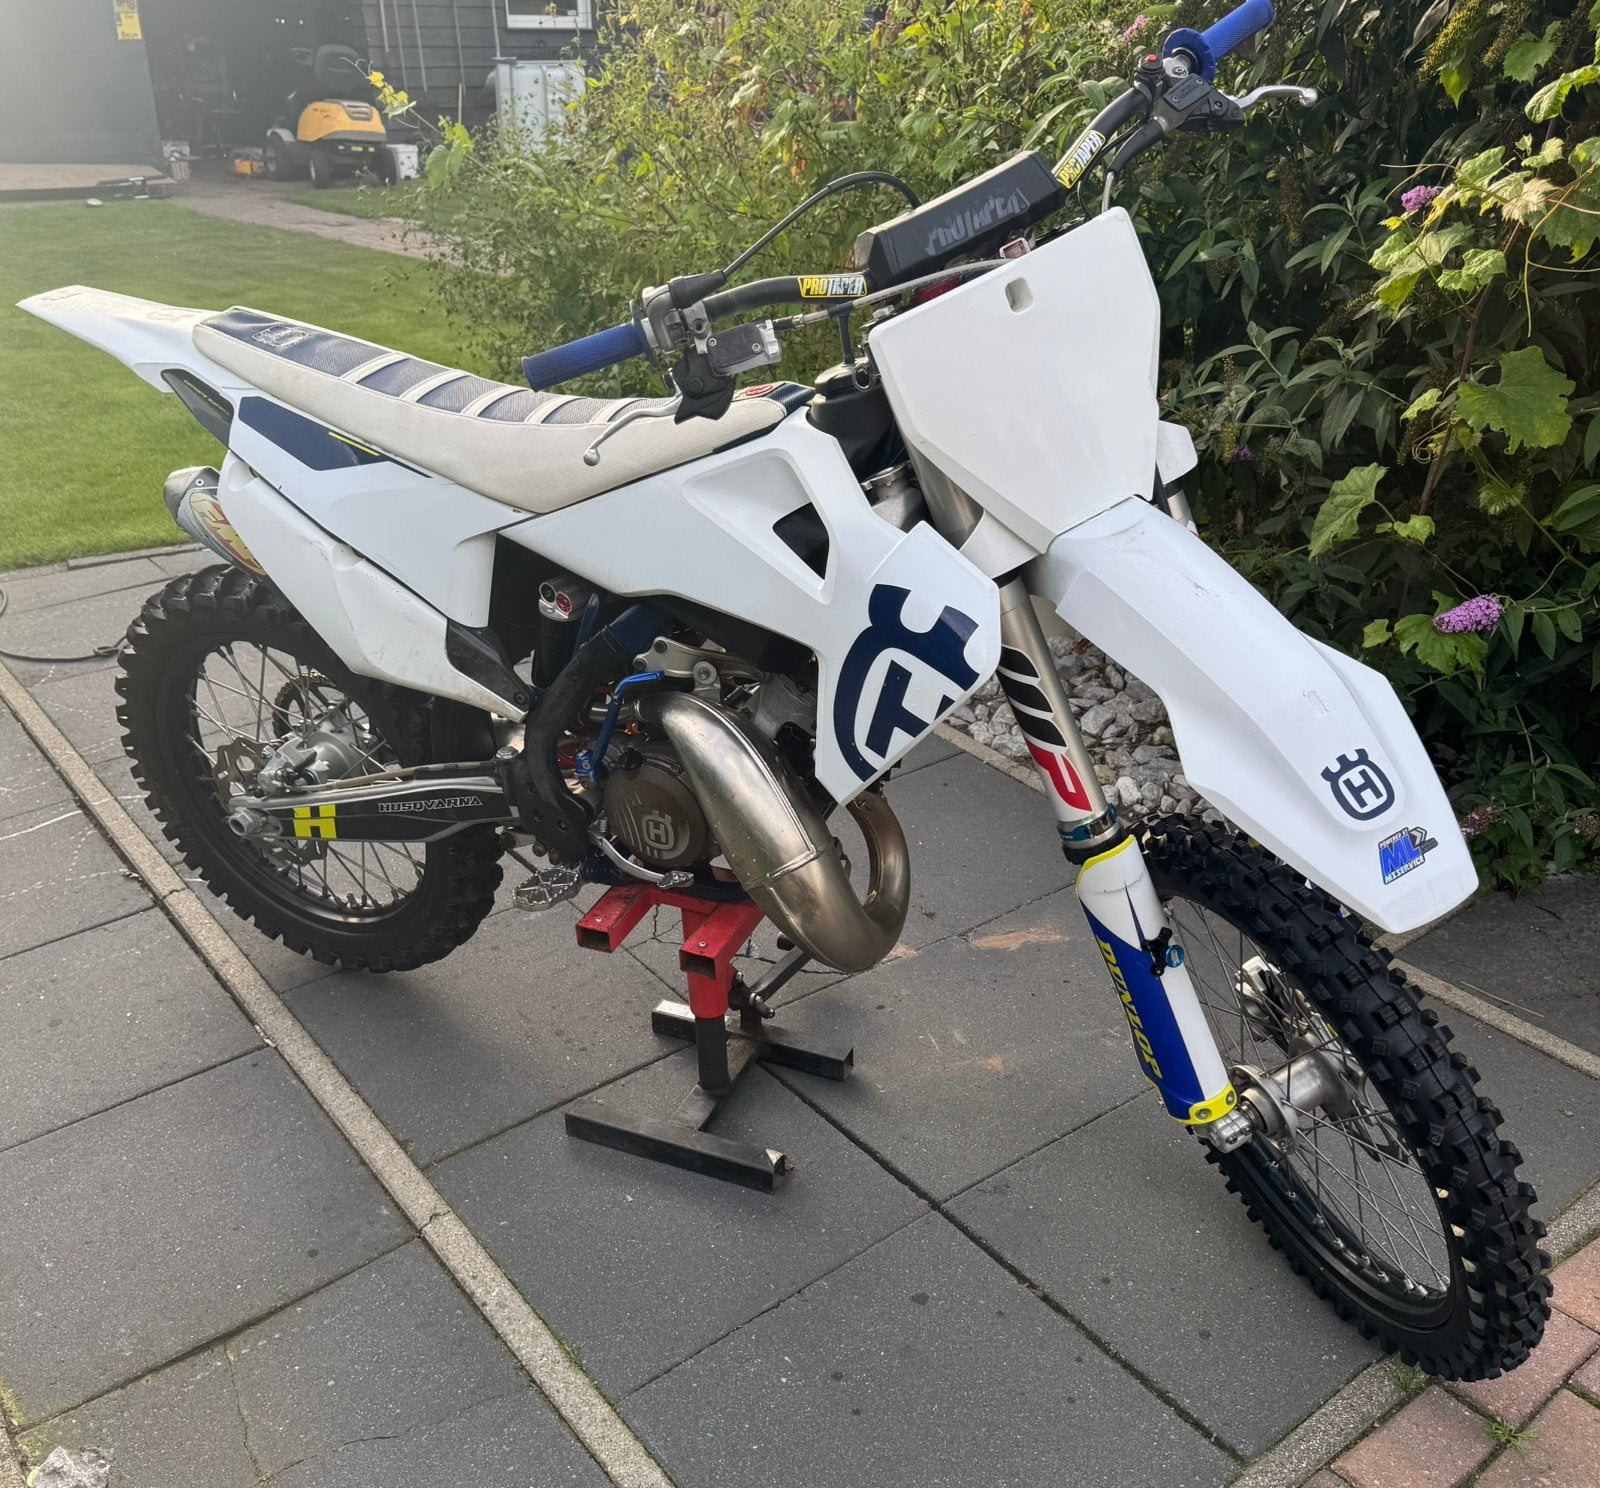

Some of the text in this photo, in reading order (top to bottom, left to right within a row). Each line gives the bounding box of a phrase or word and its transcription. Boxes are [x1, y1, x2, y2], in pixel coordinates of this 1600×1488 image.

[802, 277, 864, 296] PROTAPER
[378, 796, 483, 812] HUSQVARNA
[1381, 833, 1422, 876] ML
